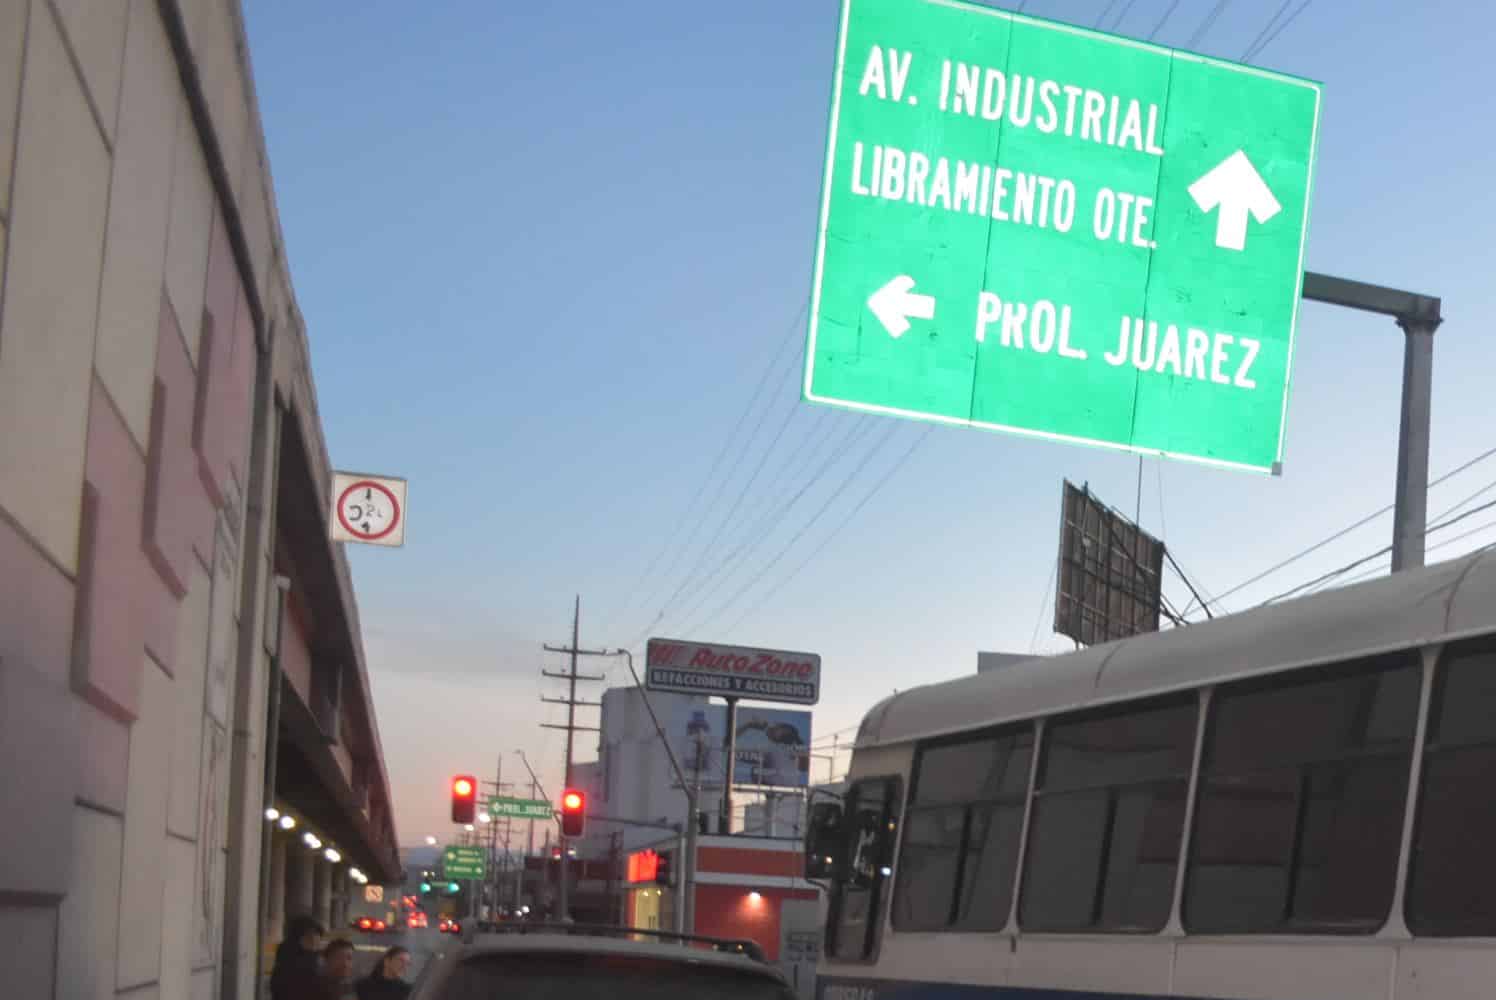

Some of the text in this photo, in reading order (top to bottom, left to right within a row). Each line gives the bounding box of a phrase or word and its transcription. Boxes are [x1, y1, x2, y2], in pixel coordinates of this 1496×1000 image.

[859, 45, 1164, 156] AV. INDUSTRIAL
[851, 142, 1158, 249] LIBRAMIENTO OTE.
[1103, 316, 1261, 389] JUAREZ
[689, 649, 814, 679] AutoZone
